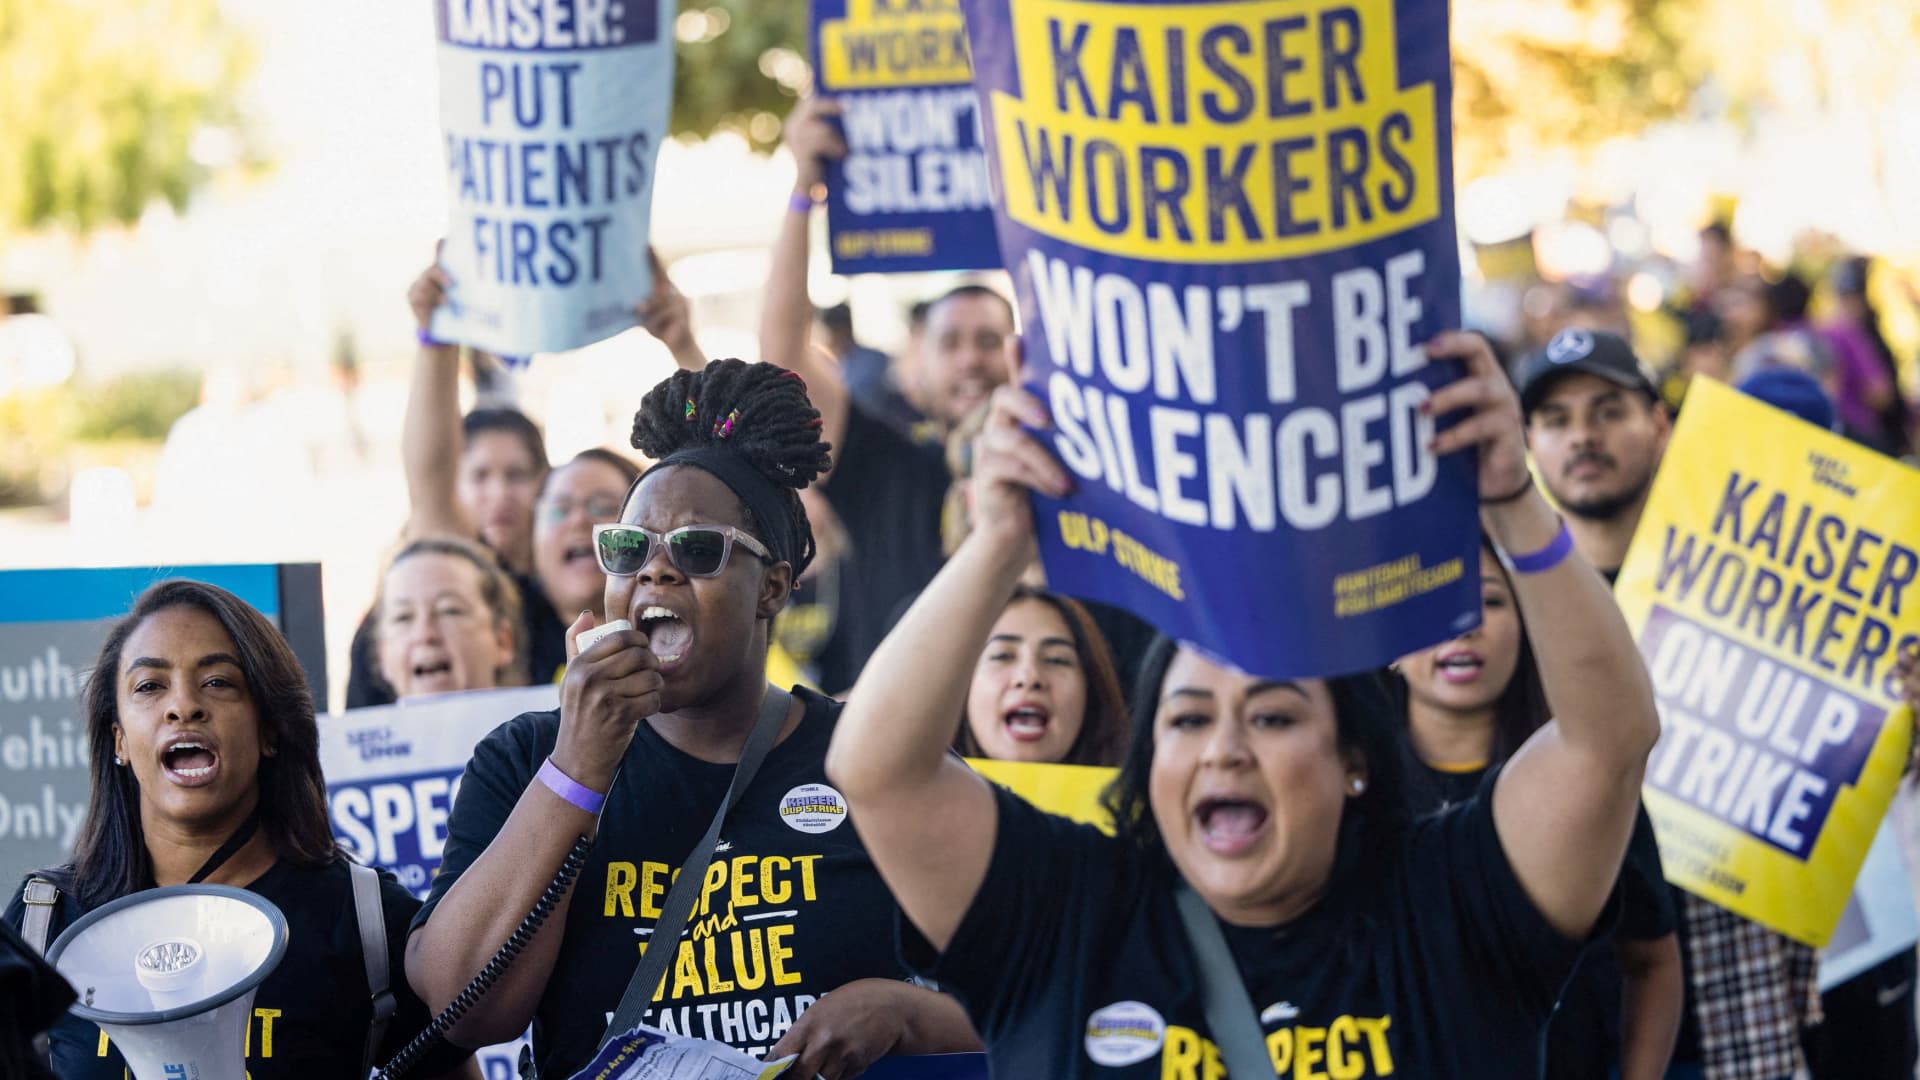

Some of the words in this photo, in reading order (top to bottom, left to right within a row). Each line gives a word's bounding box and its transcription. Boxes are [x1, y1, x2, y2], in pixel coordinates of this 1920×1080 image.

[480, 62, 582, 128] PUT
[1047, 6, 1366, 126] KAISER
[1016, 112, 1416, 244] WORKERS
[475, 215, 611, 287] FIRST
[1027, 249, 1311, 404] WON'T
[1332, 250, 1430, 393] BE
[1048, 381, 1438, 531] SILENCED
[1058, 510, 1108, 555] ULP
[1111, 529, 1184, 602] STRIKE
[1712, 470, 1919, 617] KAISER
[1653, 624, 1742, 718] ON
[1736, 660, 1859, 766] ULP
[327, 774, 461, 868] SPE
[786, 795, 837, 808] KAISER
[805, 804, 843, 814] STRIKE
[1652, 702, 1828, 851] TRIKE
[692, 900, 738, 942] and
[608, 1053, 626, 1069] Are
[1160, 1014, 1395, 1080] REPECT
